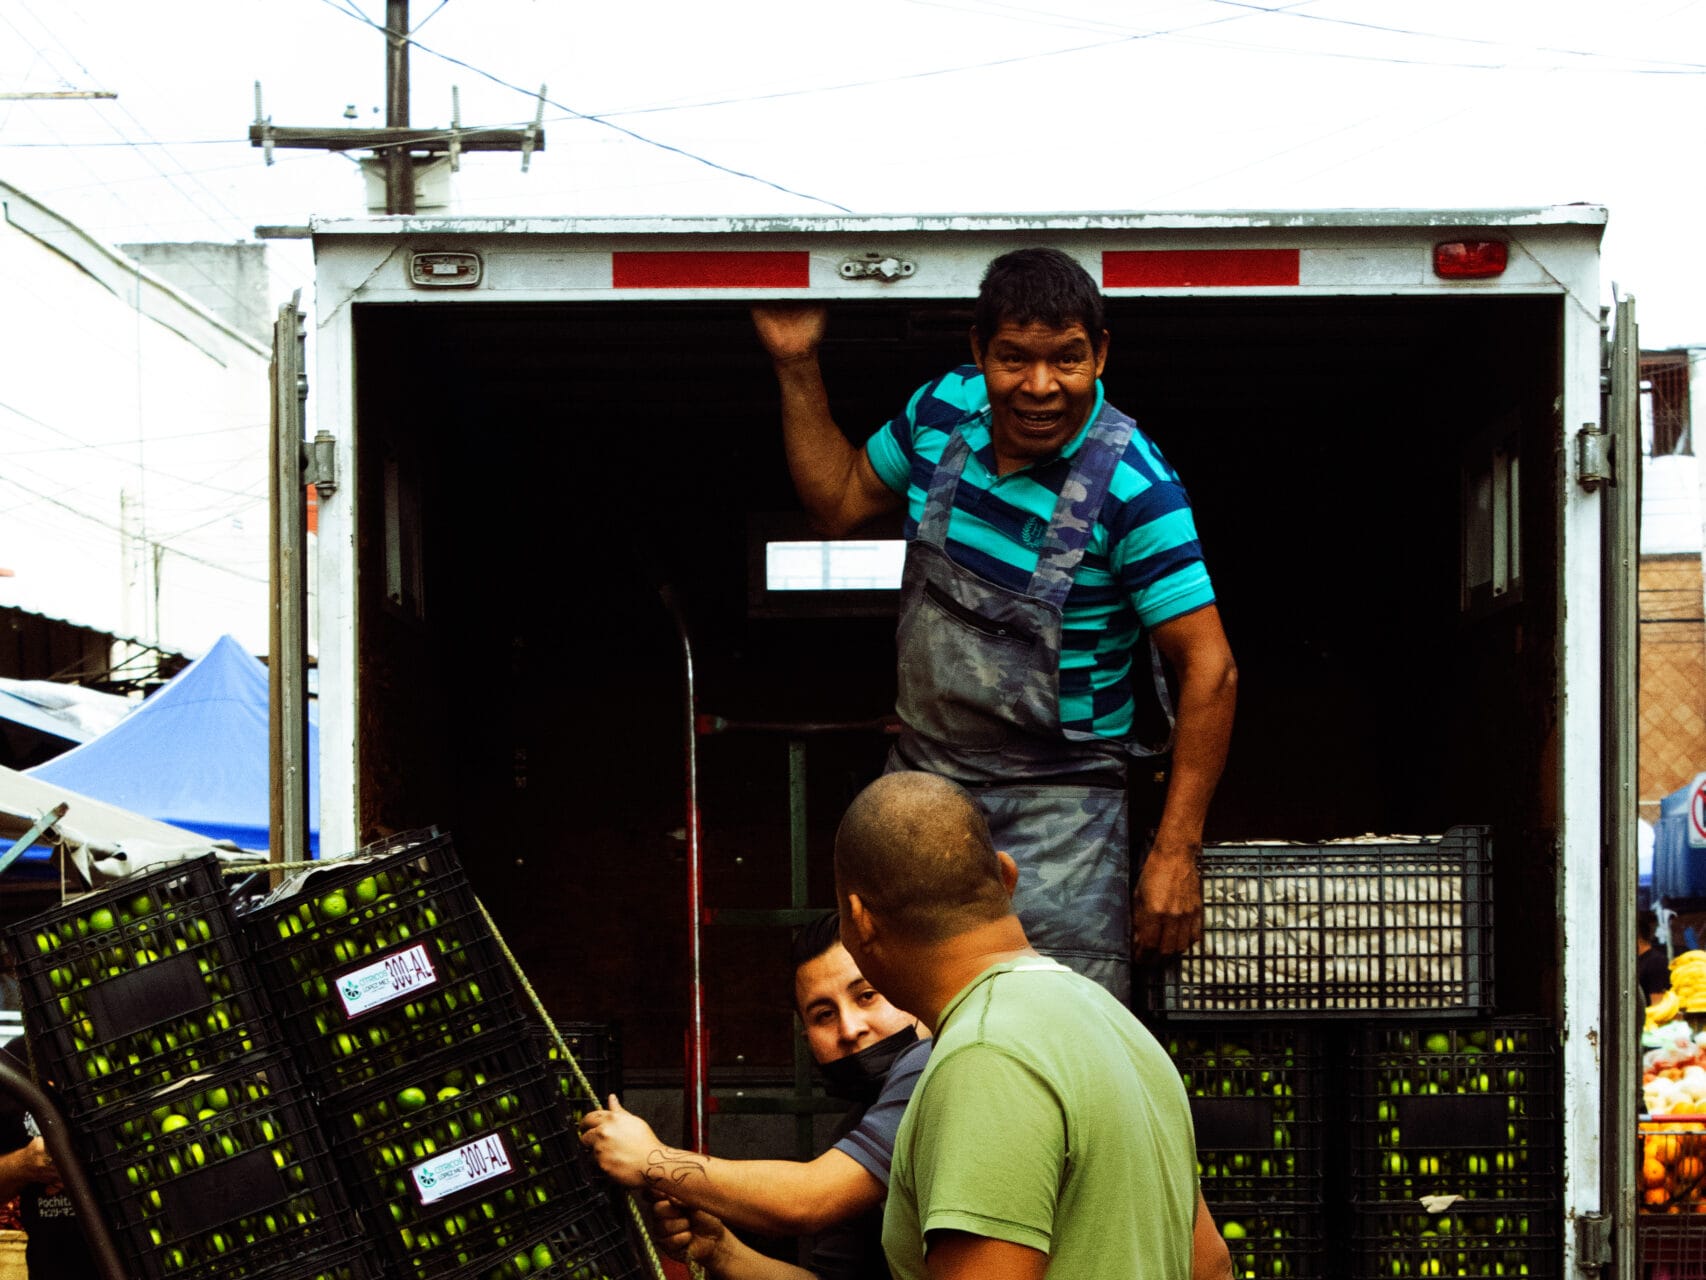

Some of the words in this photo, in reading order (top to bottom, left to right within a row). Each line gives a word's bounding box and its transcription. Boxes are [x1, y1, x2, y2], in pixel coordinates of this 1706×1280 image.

[359, 969, 389, 986] CITRICOS
[385, 948, 432, 991] 300-AL
[460, 1137, 507, 1179] 300-AL
